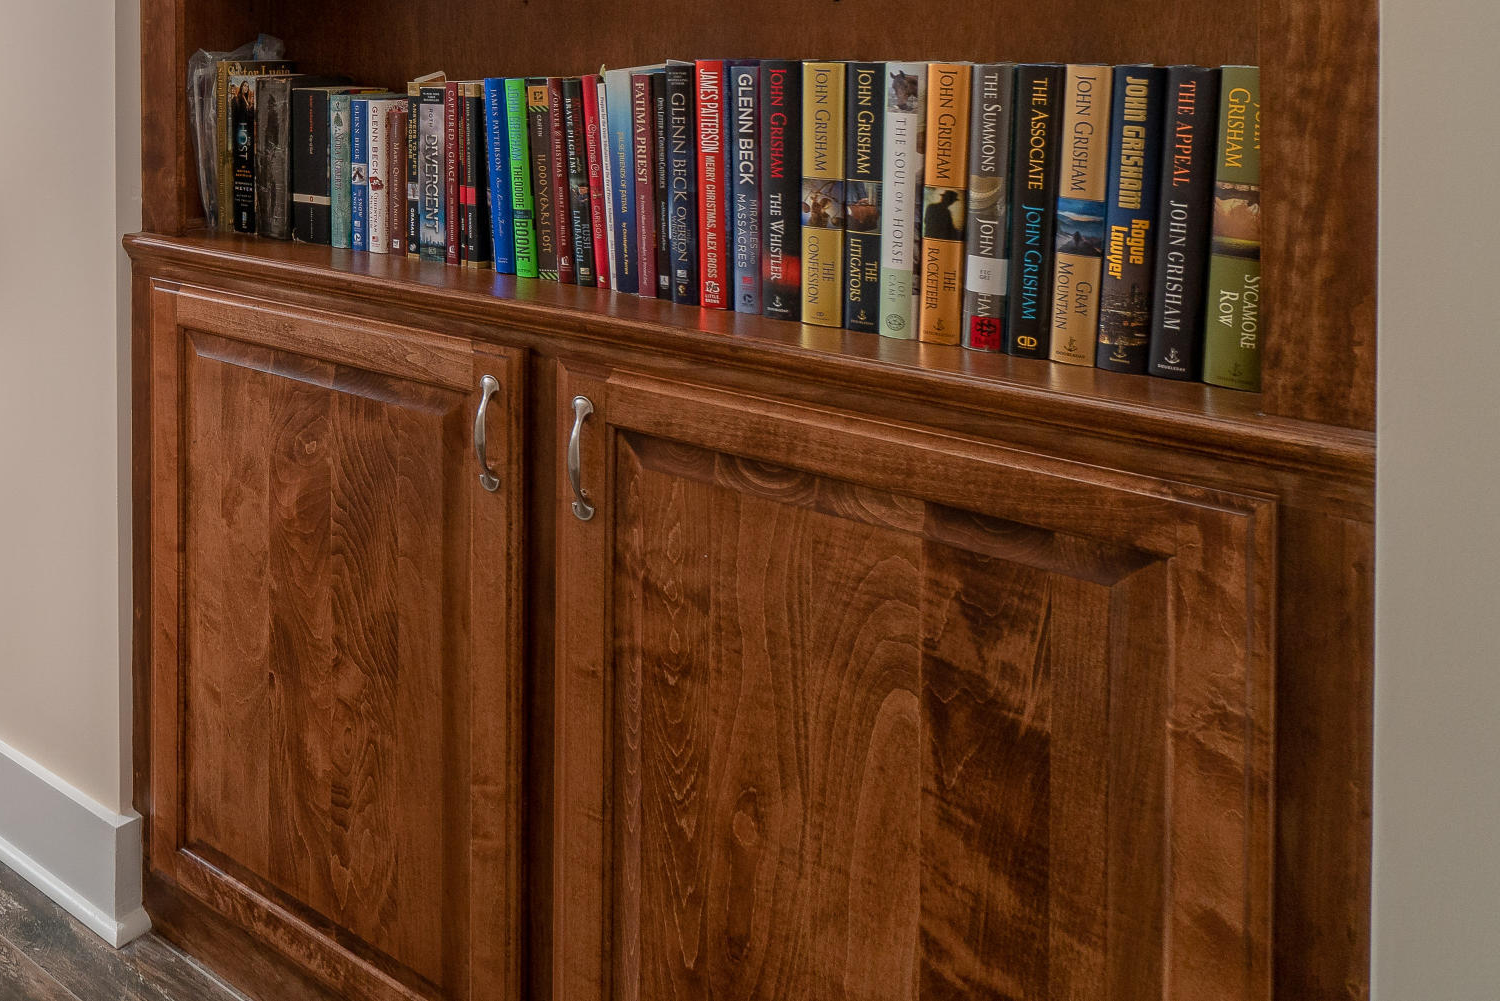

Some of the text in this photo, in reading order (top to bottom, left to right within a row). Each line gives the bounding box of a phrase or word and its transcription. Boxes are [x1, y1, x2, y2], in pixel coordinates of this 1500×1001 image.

[238, 122, 248, 161] HOST
[334, 132, 343, 155] NORA
[371, 106, 379, 142] GLENN
[490, 89, 502, 171] JAMES PATTERSON
[507, 86, 522, 161] JOHN GRISHAM
[565, 97, 577, 174] BRAVE PILGRIMS
[587, 124, 598, 162] Christmas
[635, 82, 648, 185] FATIMA PRIEST
[671, 93, 687, 154] GLENN
[738, 73, 754, 185] GLENN BECK
[814, 69, 831, 171] JOHN GRISHAM
[856, 69, 875, 174] JOHN GRISHAM
[895, 117, 906, 145] THE
[937, 70, 957, 180] JOHN GRISHAM
[982, 72, 1002, 173] THE SUMMONS
[1070, 75, 1096, 192] JOHN GRISHAM
[1118, 76, 1149, 210] JOHN GRISHAM
[1225, 87, 1250, 169] GRISHAM
[412, 142, 418, 152] TO
[590, 163, 600, 178] Cat
[894, 151, 906, 187] SOUL
[424, 134, 438, 233] DIVERGENT
[513, 166, 525, 208] THEODORE
[620, 179, 626, 188] OF
[673, 159, 688, 202] BECK
[700, 68, 719, 279] JAMES PATTERSON MERRY CHRISTMAS, ALEX CROSS
[770, 68, 787, 281] JOHN GRISHAM THE WHISTLER
[1021, 77, 1048, 321] THE ASSOCIATE JOHN GRISHAM
[539, 185, 550, 225] YEARS
[594, 205, 602, 239] CARLSON
[619, 189, 628, 213] FATIMA
[749, 199, 758, 249] MIRACLES
[1163, 80, 1196, 331] THE APPEAL JOHN GRISHAM
[515, 220, 530, 262] BOONE
[542, 230, 551, 253] LOST
[573, 210, 584, 262] LIMBAUGH
[582, 223, 591, 249] RUSH
[676, 206, 688, 262] OVERTON
[736, 194, 747, 268] MASSACRES
[892, 217, 904, 265] HORSE
[979, 217, 998, 256] JOHN
[1108, 225, 1129, 280] Lawyer
[1128, 219, 1150, 265] Rogue
[807, 235, 820, 305] CONFESSION
[823, 261, 835, 282] THE
[849, 238, 862, 302] LITIGATORS
[865, 261, 877, 283] THE
[888, 274, 896, 303] CAMP
[925, 247, 940, 310] RACKETEER
[943, 269, 957, 292] THE
[1055, 261, 1074, 330] MOUNTAIN
[1075, 281, 1092, 316] GRAY
[1217, 289, 1239, 328] ROW
[1239, 274, 1260, 349] SYCAMORE
